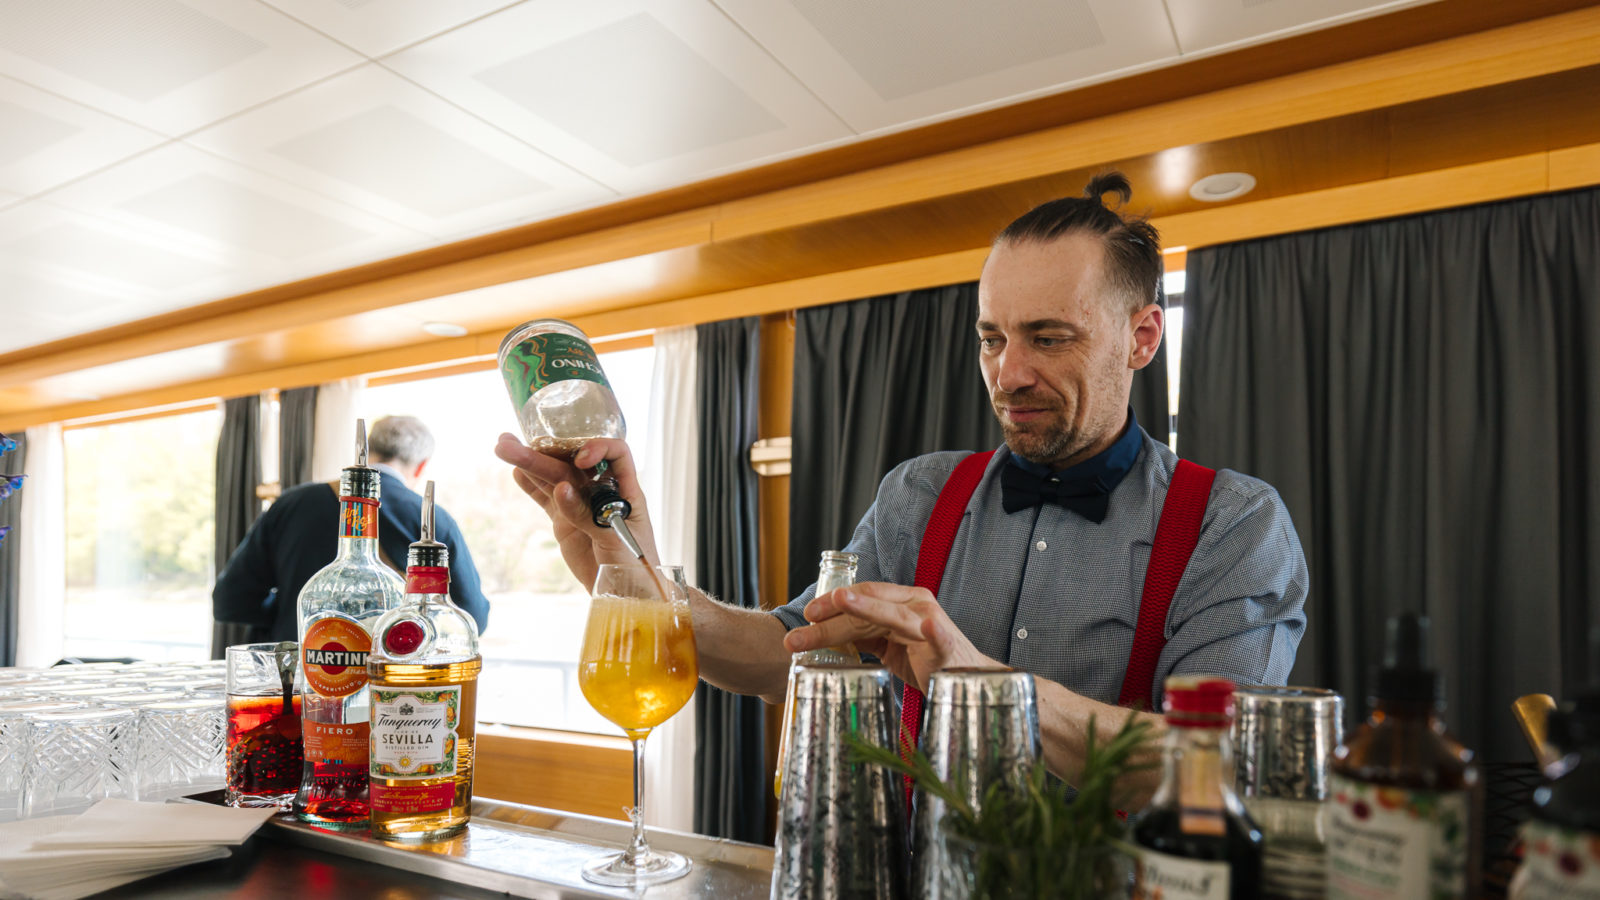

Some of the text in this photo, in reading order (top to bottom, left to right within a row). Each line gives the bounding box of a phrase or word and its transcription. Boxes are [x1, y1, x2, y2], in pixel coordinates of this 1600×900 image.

[378, 713, 442, 730] Tanqueray
[316, 726, 354, 735] FIERO
[382, 734, 434, 745] SEVILLA
